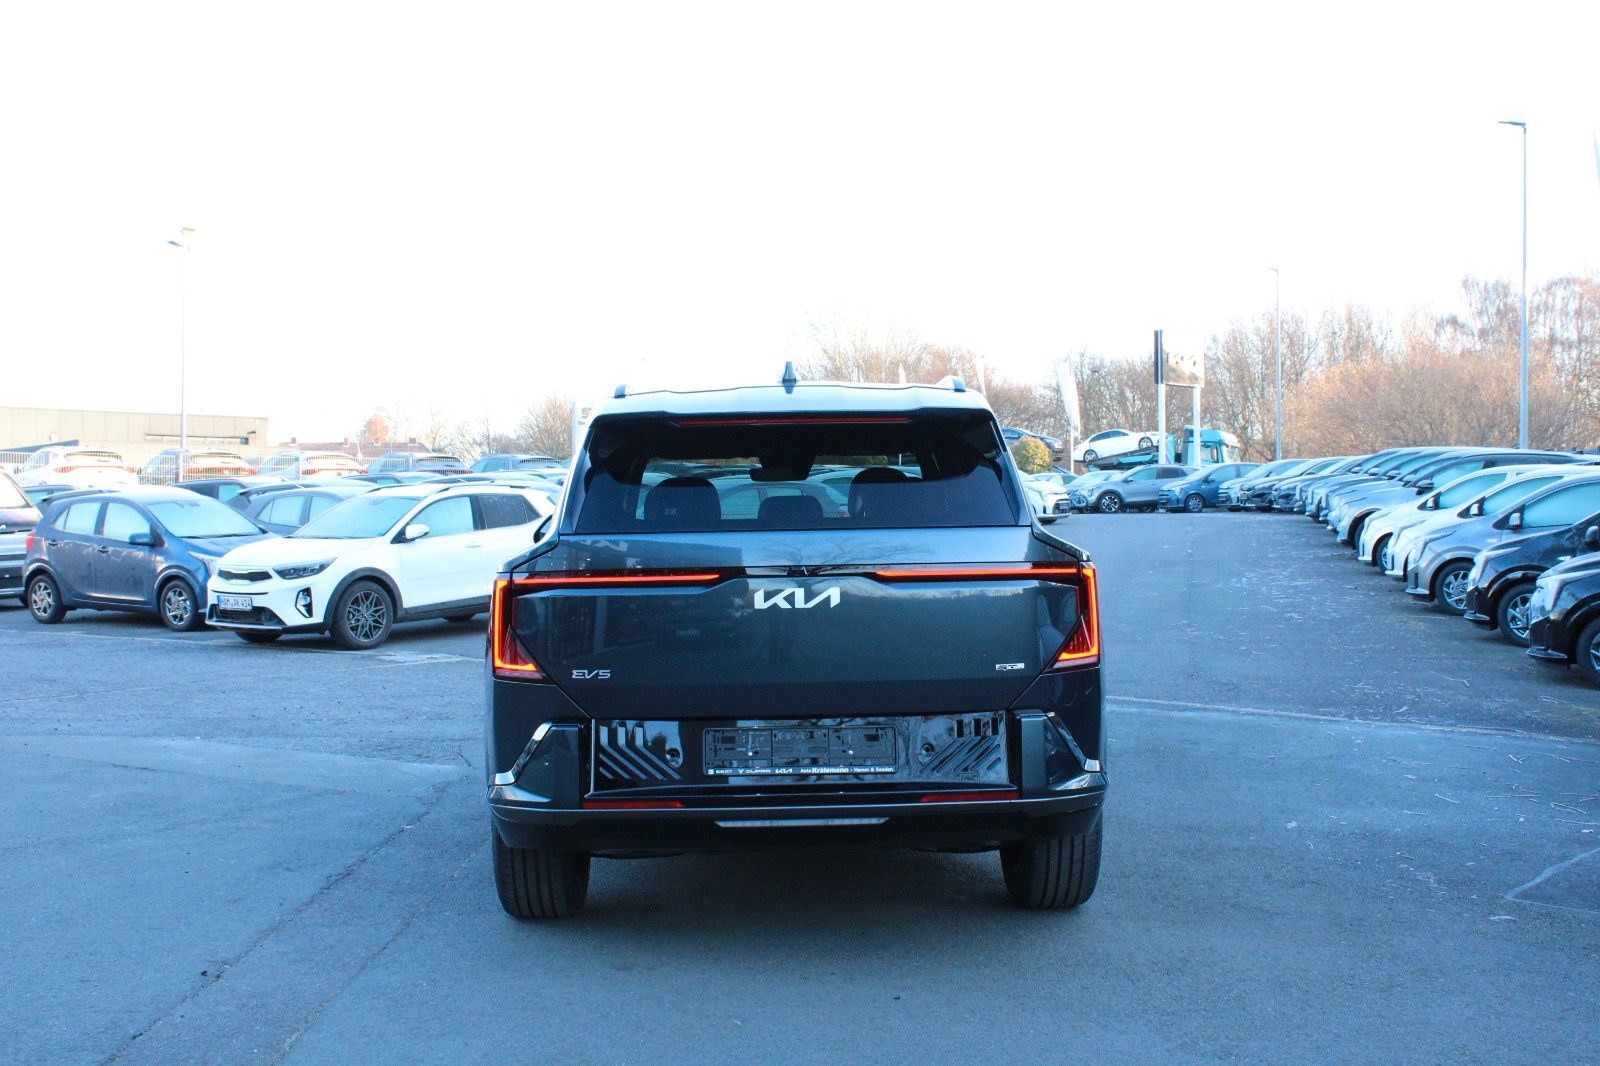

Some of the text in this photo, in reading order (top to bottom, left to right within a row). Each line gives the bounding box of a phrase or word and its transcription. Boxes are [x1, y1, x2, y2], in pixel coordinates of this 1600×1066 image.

[754, 587, 841, 609] KIA
[571, 669, 611, 679] EV5
[812, 766, 849, 774] Krälemann
